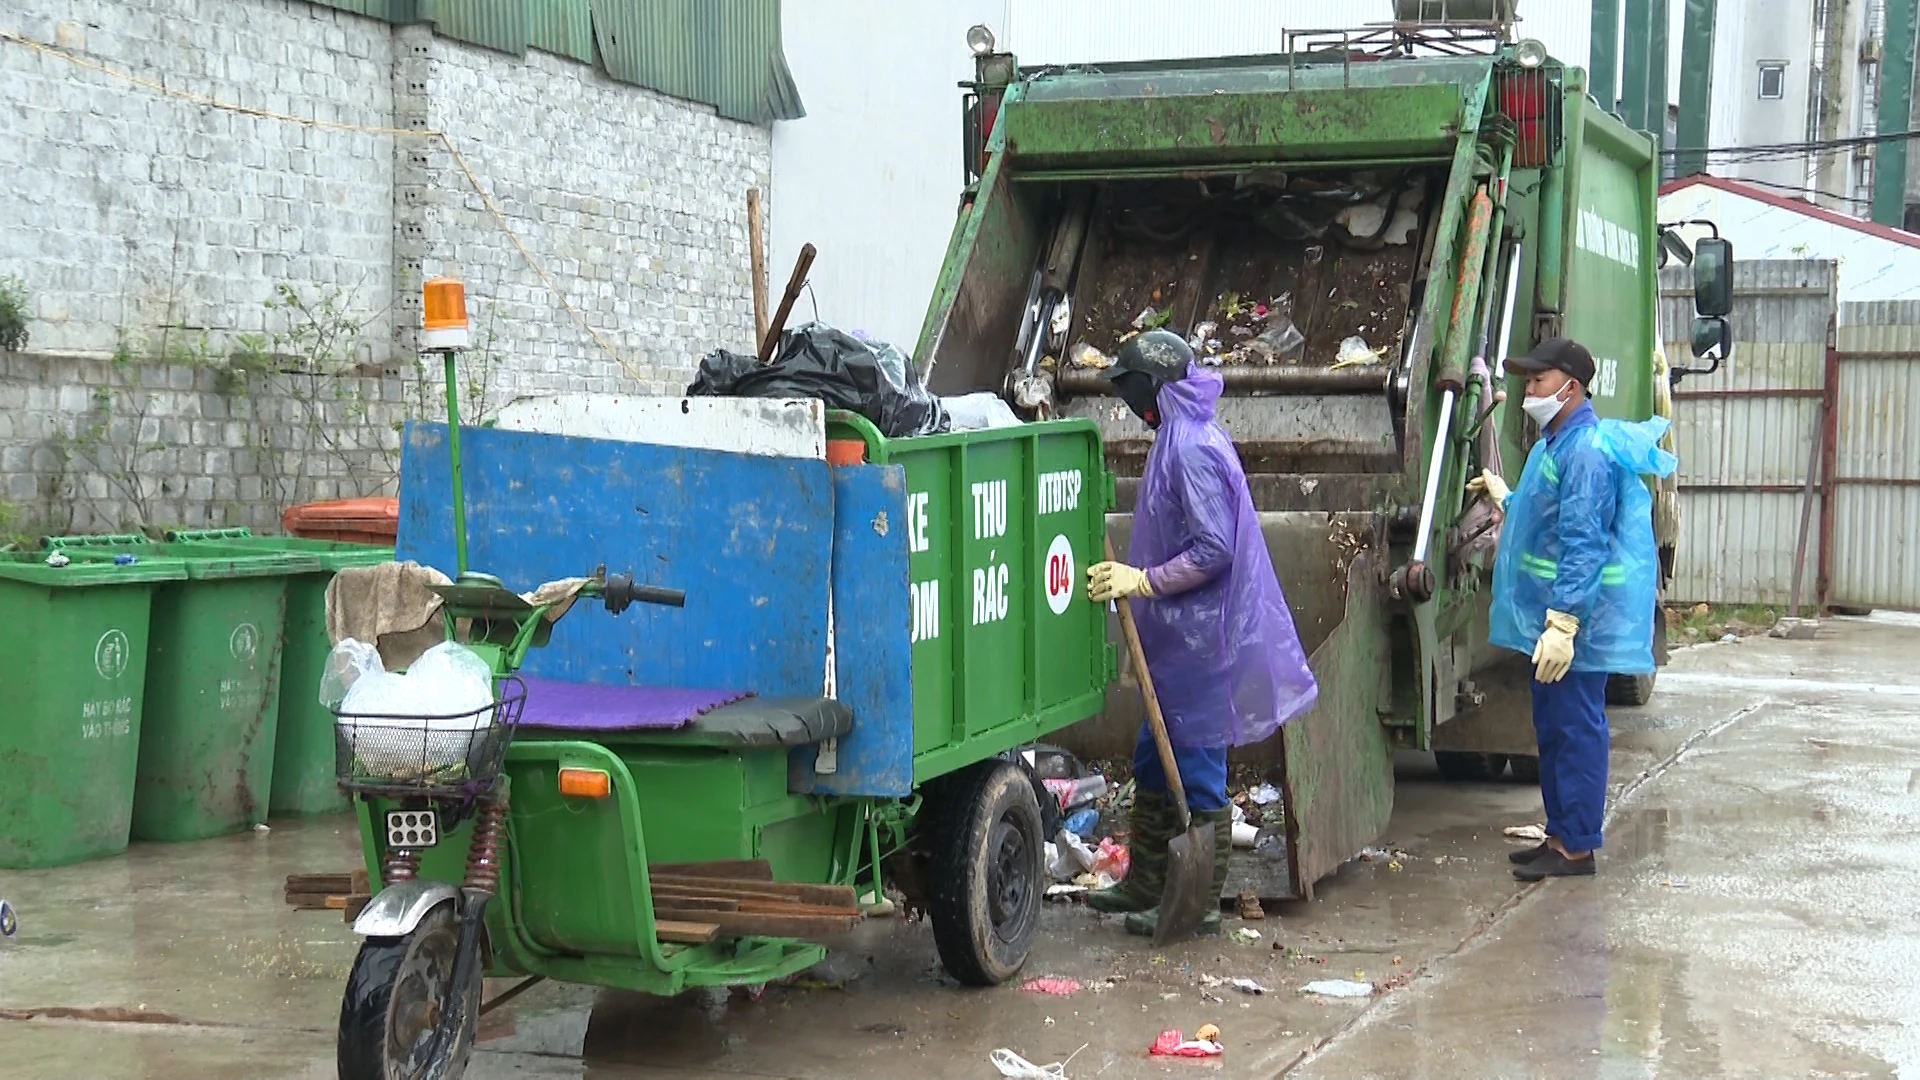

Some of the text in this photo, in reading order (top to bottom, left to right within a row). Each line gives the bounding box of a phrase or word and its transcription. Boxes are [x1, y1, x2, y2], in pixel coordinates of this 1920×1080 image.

[971, 479, 1007, 540] THU
[972, 549, 1009, 626] RÁC
[1049, 554, 1069, 596] 04
